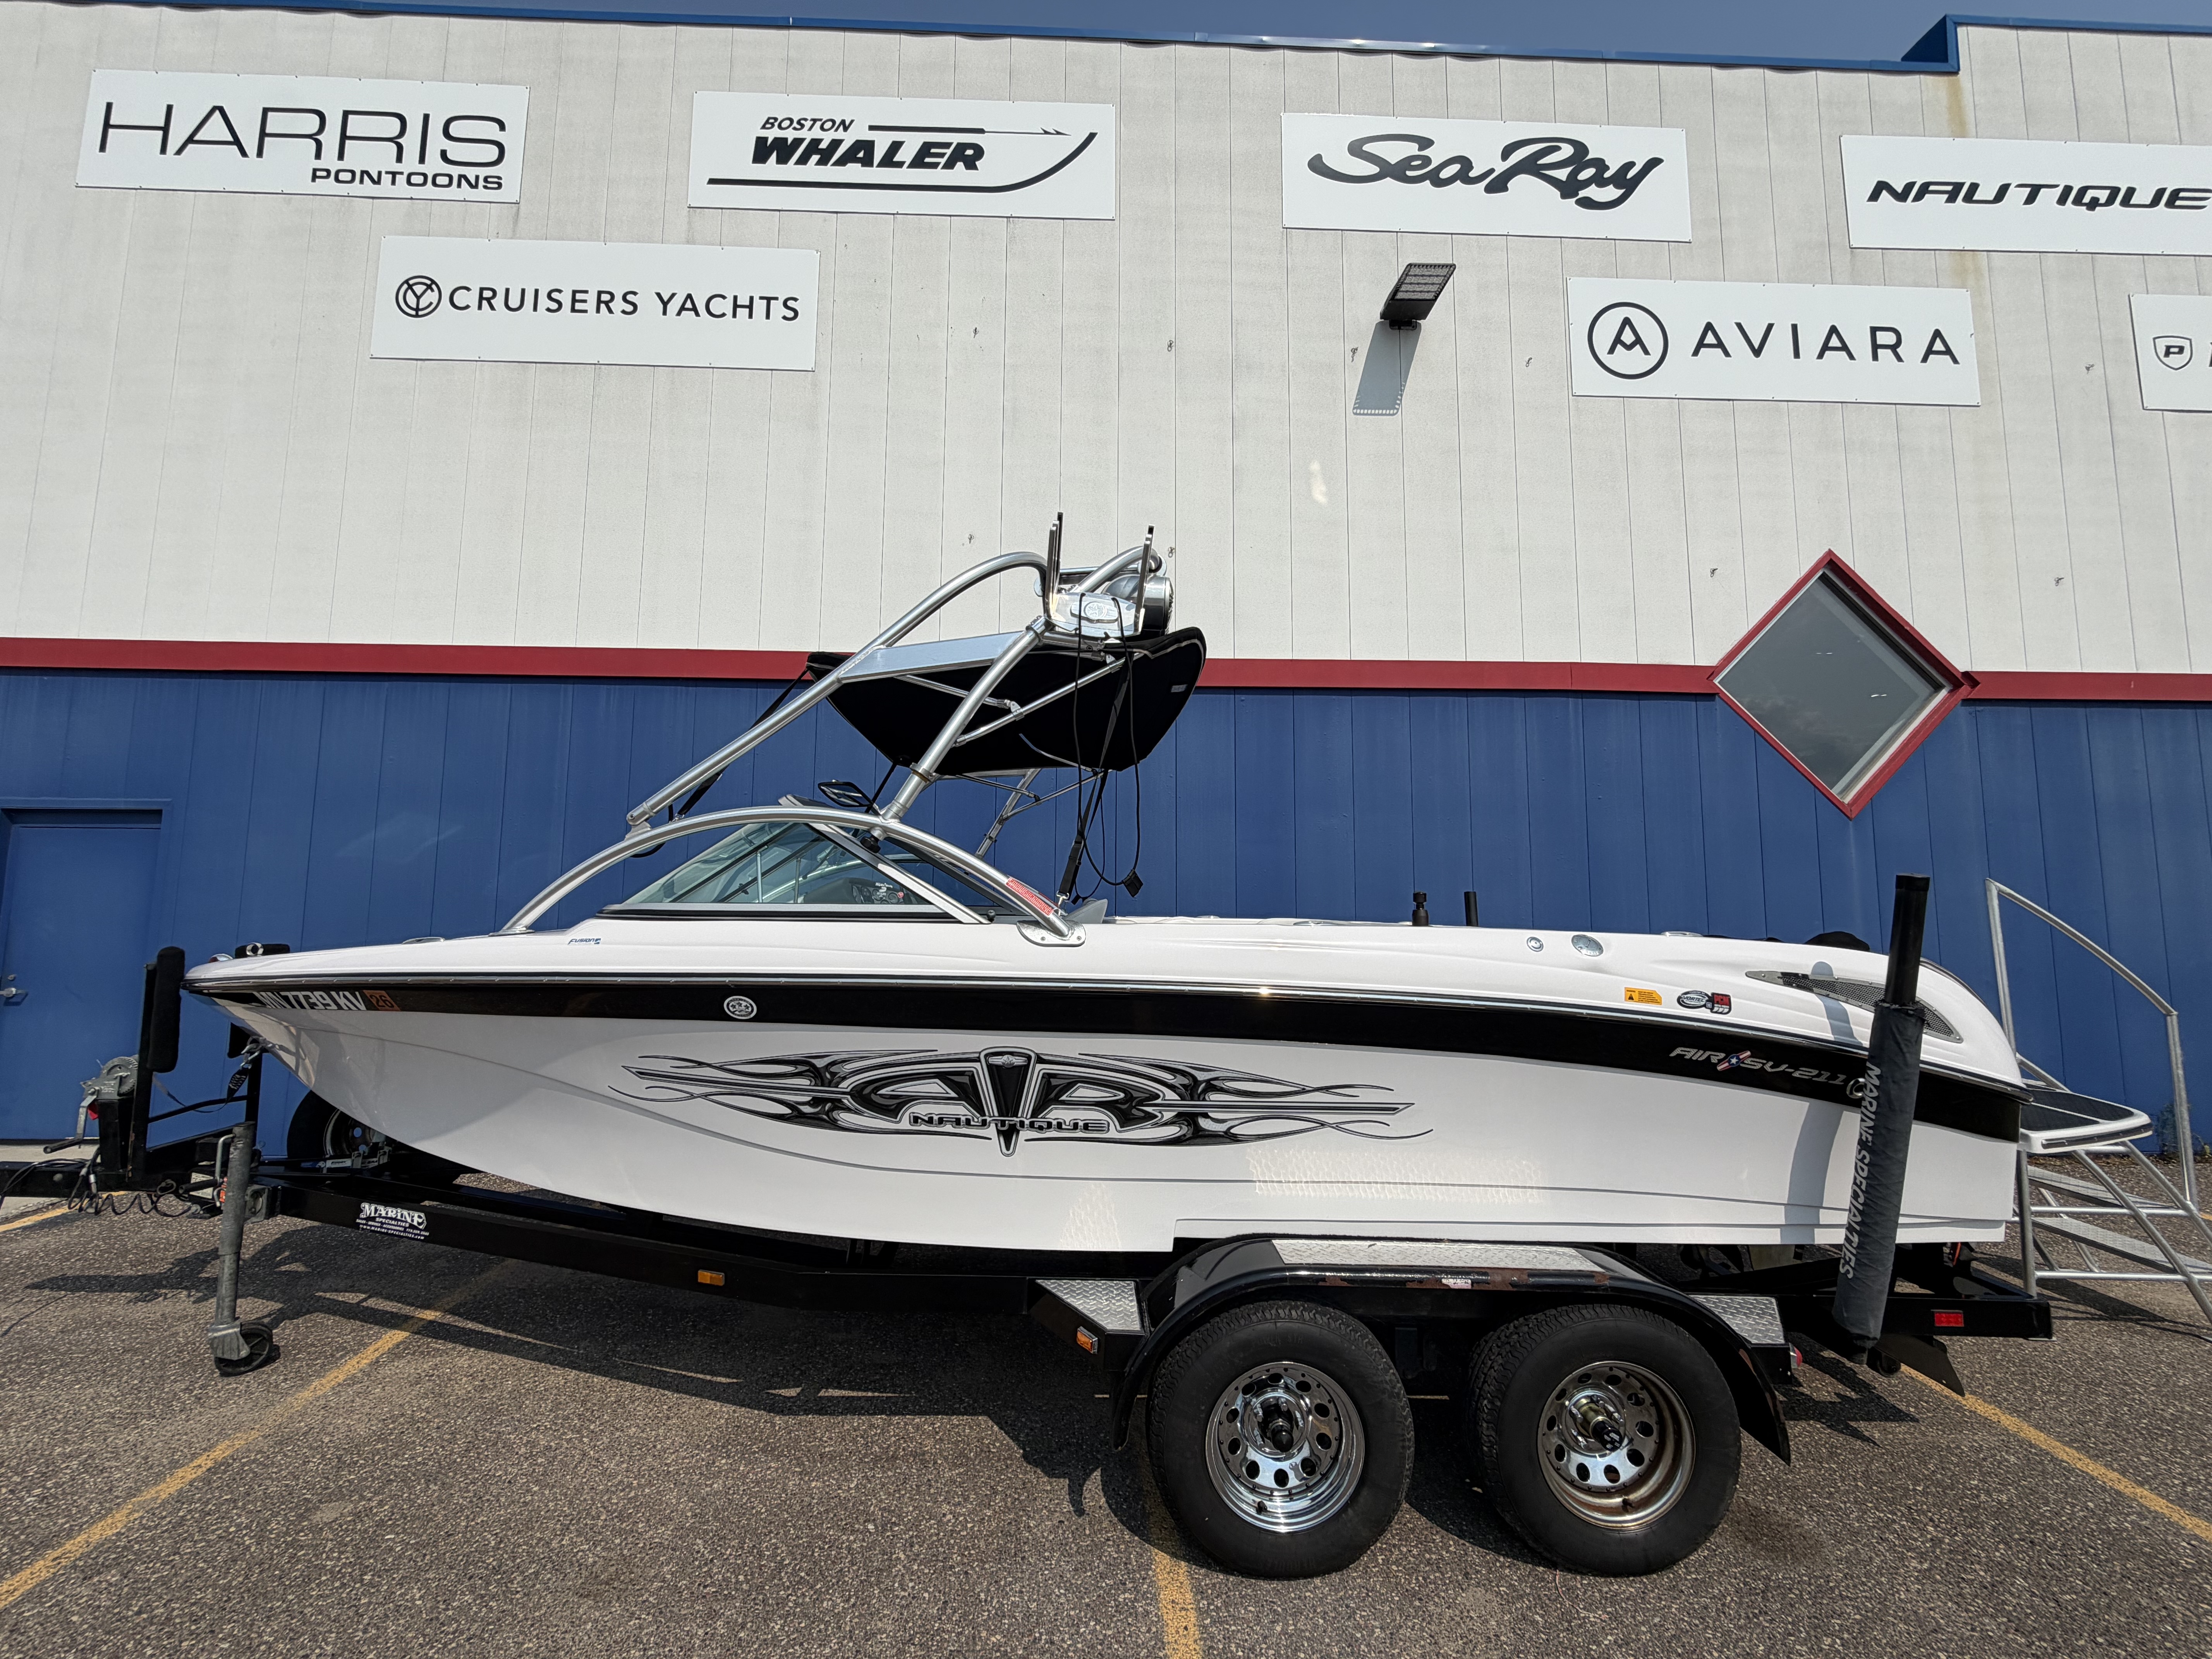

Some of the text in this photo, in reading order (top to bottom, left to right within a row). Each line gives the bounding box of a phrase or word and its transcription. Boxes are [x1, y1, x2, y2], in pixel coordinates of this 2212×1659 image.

[99, 102, 505, 167] HARRIS
[761, 117, 854, 132] BOSTON
[752, 136, 984, 170] WHALER
[311, 168, 502, 190] PONTOONS
[1308, 134, 1664, 210] Sea Ray
[1867, 181, 2212, 211] NAUTIQUE
[449, 286, 799, 321] CRUISERS YACHTS
[1692, 322, 1959, 364] AVIARA
[281, 991, 339, 1009] 7739
[331, 991, 366, 1010] KV
[369, 994, 393, 1008] 26
[1714, 994, 1729, 1006] PCM
[1669, 1047, 1846, 1084] AIR SV-211
[910, 1113, 1110, 1133] NAUTIQUE
[1839, 1061, 1881, 1279] MARINE SPECIALTIES
[375, 1218, 409, 1227] SPECIALTIES
